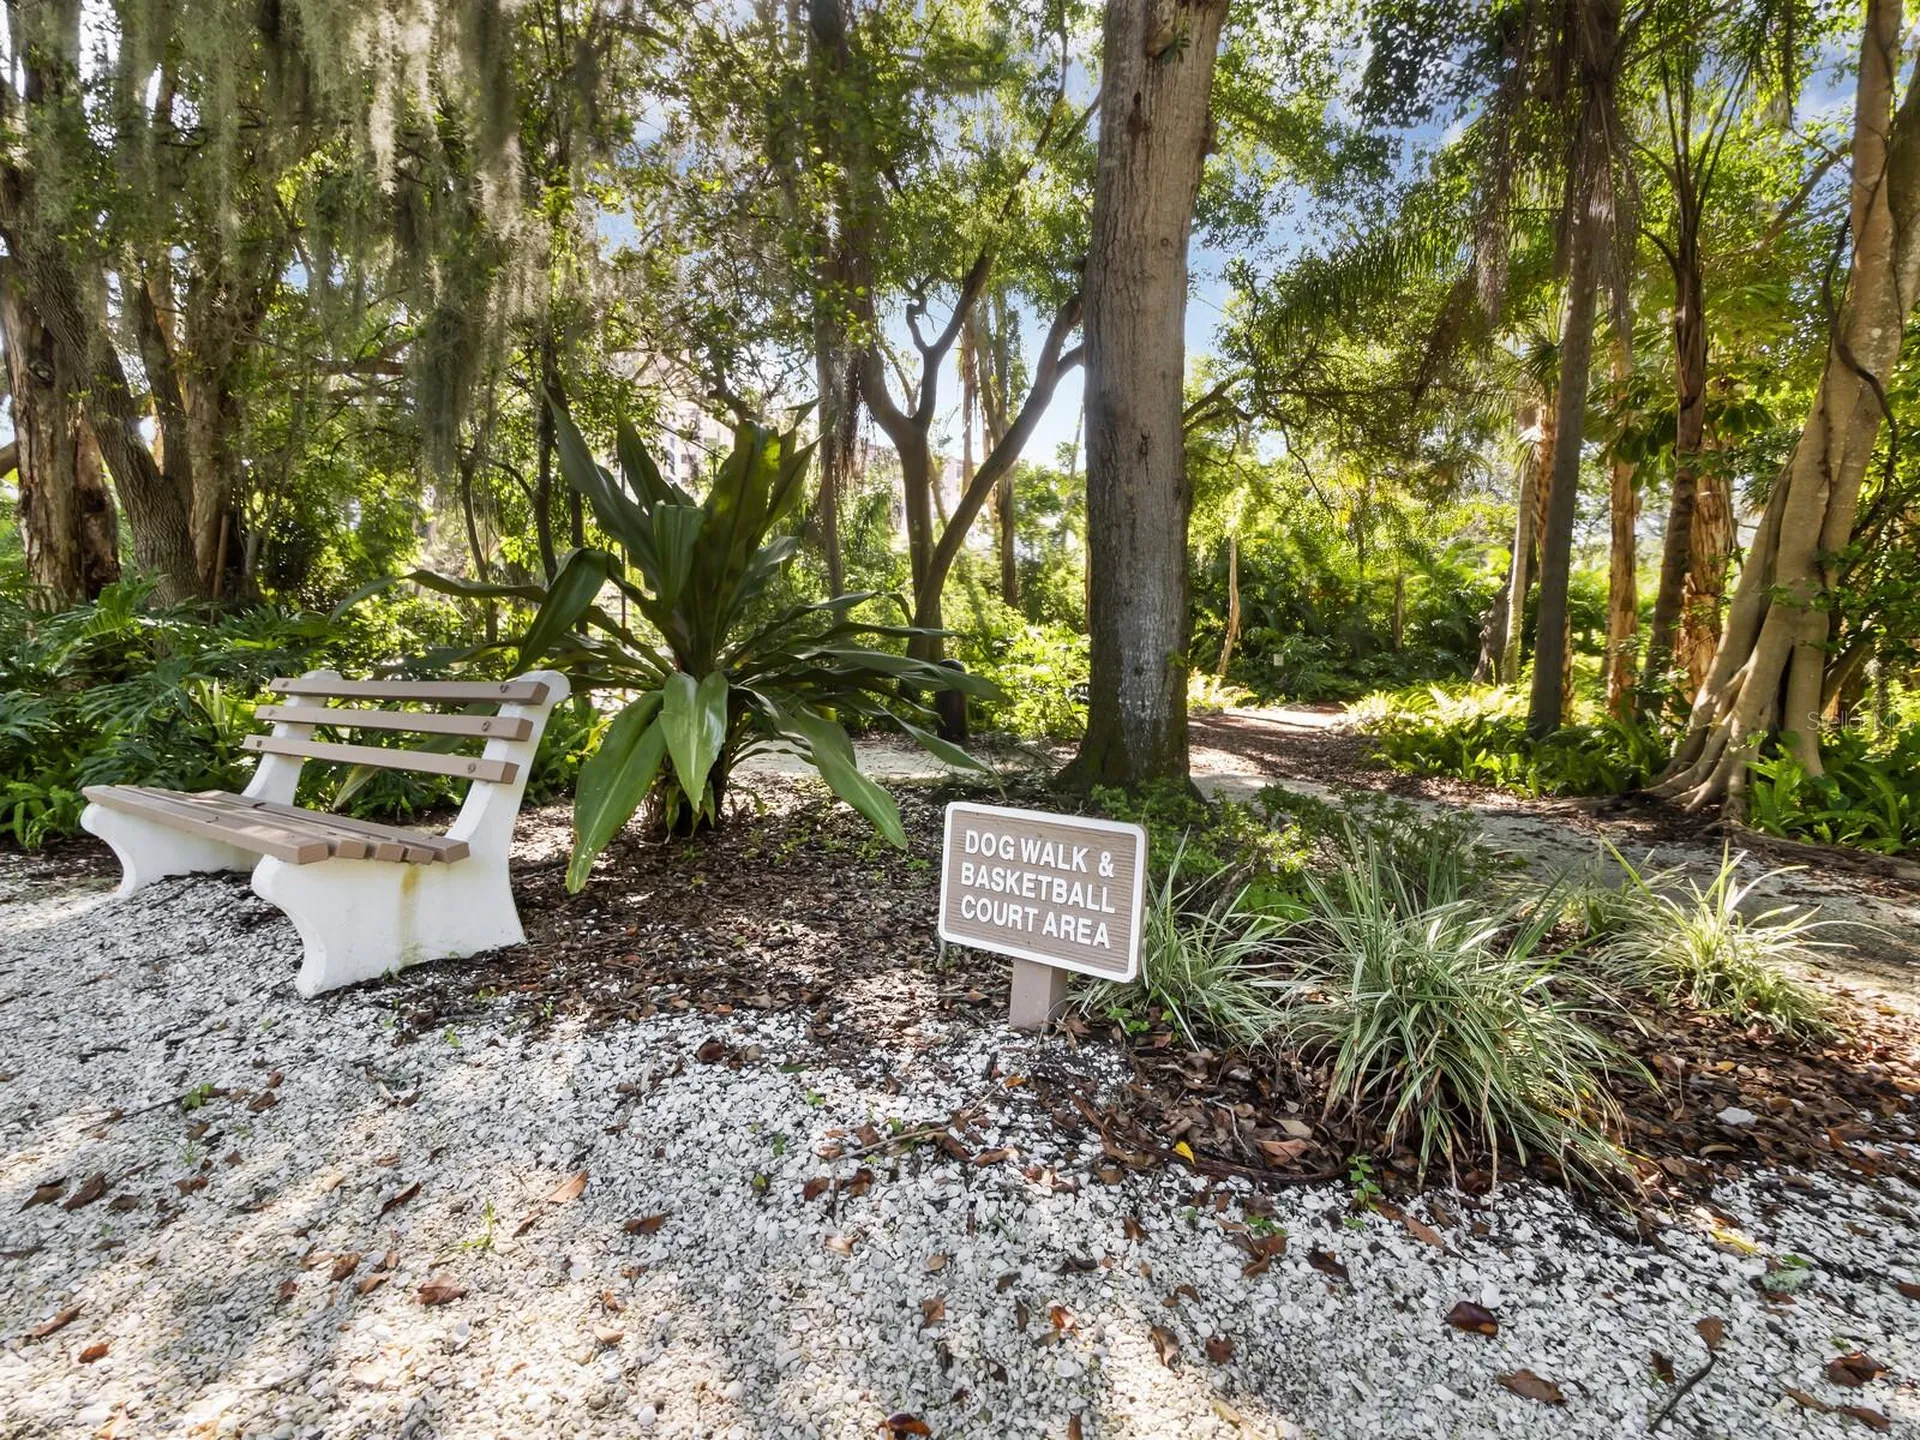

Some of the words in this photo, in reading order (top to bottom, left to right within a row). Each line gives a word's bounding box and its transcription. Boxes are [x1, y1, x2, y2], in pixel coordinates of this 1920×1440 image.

[965, 830, 1015, 861] DOG
[1020, 838, 1089, 873] WALK
[1098, 851, 1115, 878] &
[960, 862, 1116, 914] BASKETBALL
[960, 895, 1039, 932] COURT
[1042, 911, 1111, 949] AREA
